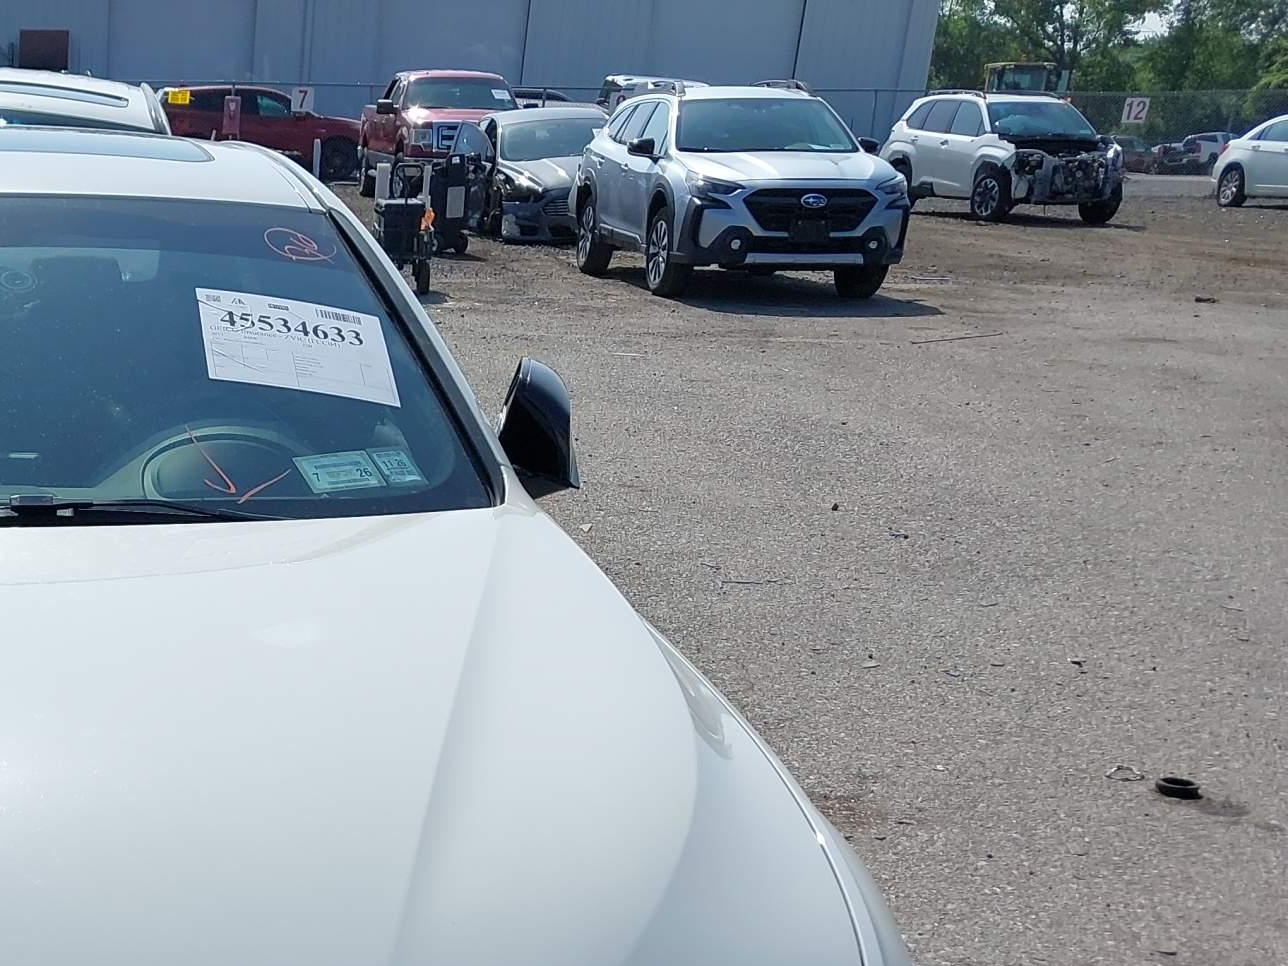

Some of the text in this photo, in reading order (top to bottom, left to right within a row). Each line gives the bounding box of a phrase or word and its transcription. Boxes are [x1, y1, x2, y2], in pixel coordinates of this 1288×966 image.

[298, 89, 309, 108] 7
[1126, 100, 1147, 121] 12
[219, 310, 365, 347] 45534633
[355, 467, 373, 478] 26
